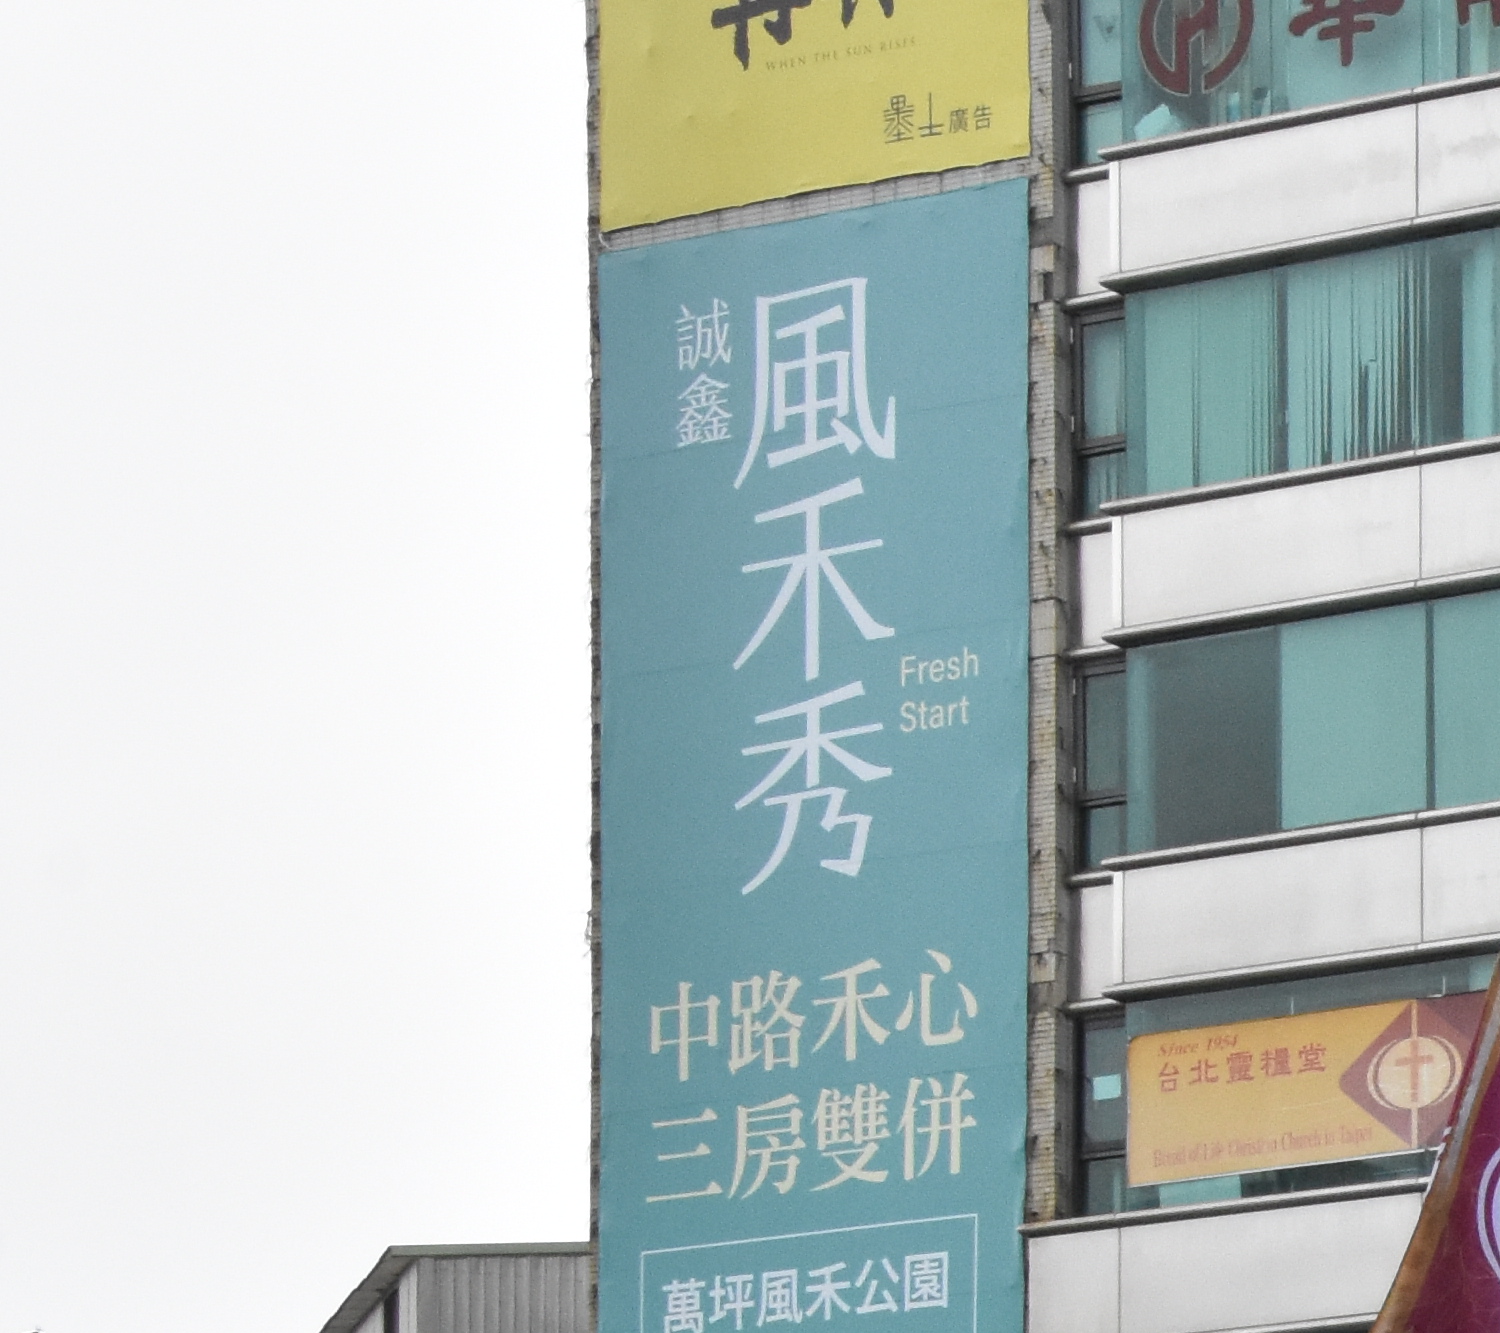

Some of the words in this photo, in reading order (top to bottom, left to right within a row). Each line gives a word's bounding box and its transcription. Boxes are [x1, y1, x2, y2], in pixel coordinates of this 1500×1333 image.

[814, 49, 839, 63] THE
[675, 298, 733, 449] 誠鑫
[733, 276, 896, 896] 風禾秀
[900, 648, 980, 688] Fresh
[900, 695, 970, 735] Start
[648, 948, 978, 1083] 中路禾心
[1158, 1041, 1198, 1058] Since
[1158, 1043, 1327, 1093] 台北靈糧堂
[645, 1071, 978, 1203] 三房雙併
